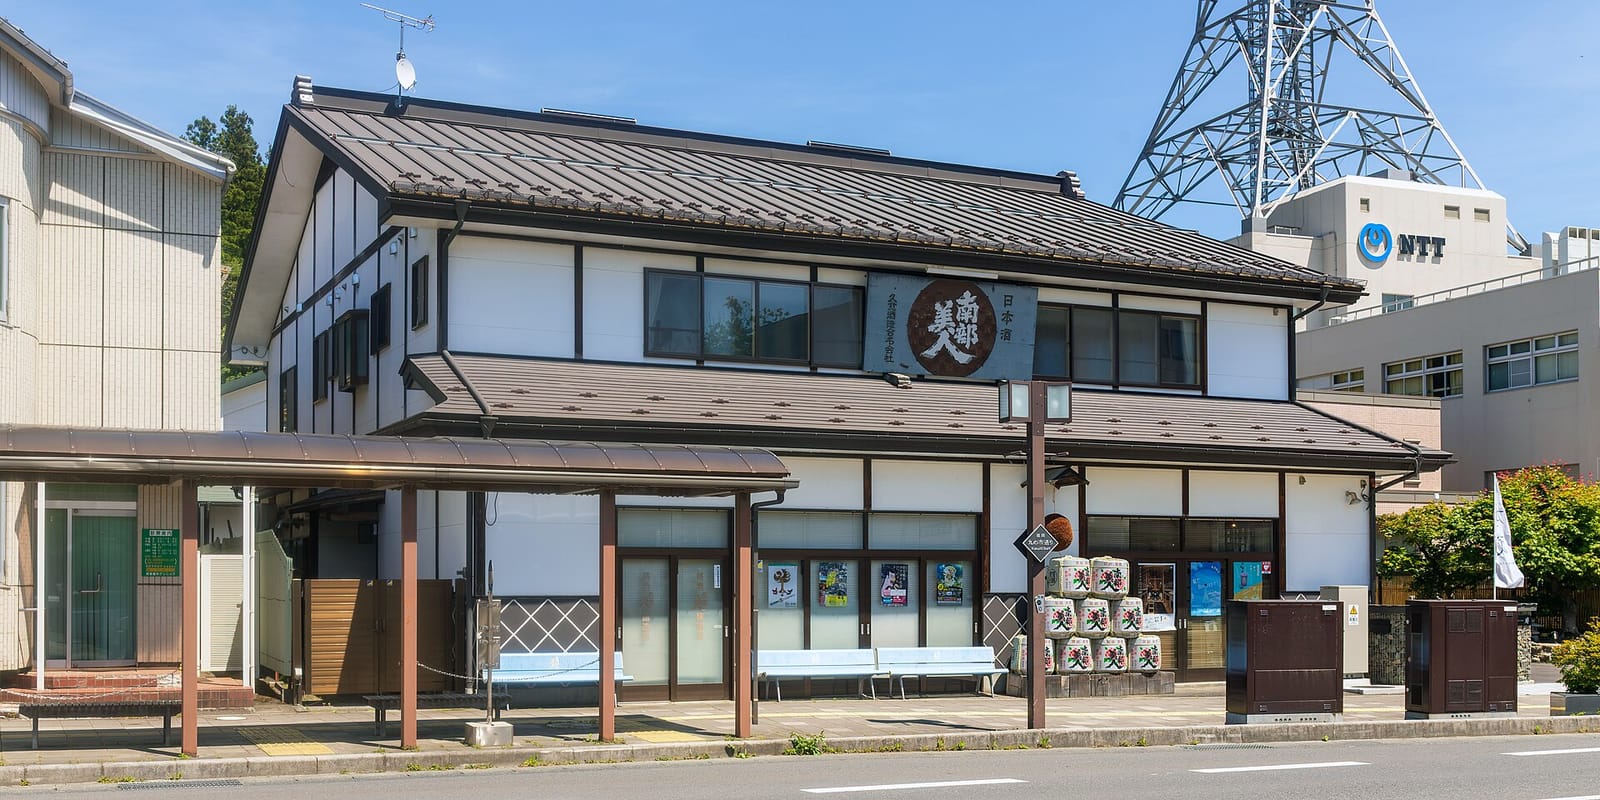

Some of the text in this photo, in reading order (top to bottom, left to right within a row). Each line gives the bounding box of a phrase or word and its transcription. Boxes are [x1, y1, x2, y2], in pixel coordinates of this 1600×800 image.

[1399, 233, 1446, 258] NTT
[920, 299, 977, 364] 美人
[954, 290, 979, 350] 南部
[1000, 294, 1014, 342] 日本酒
